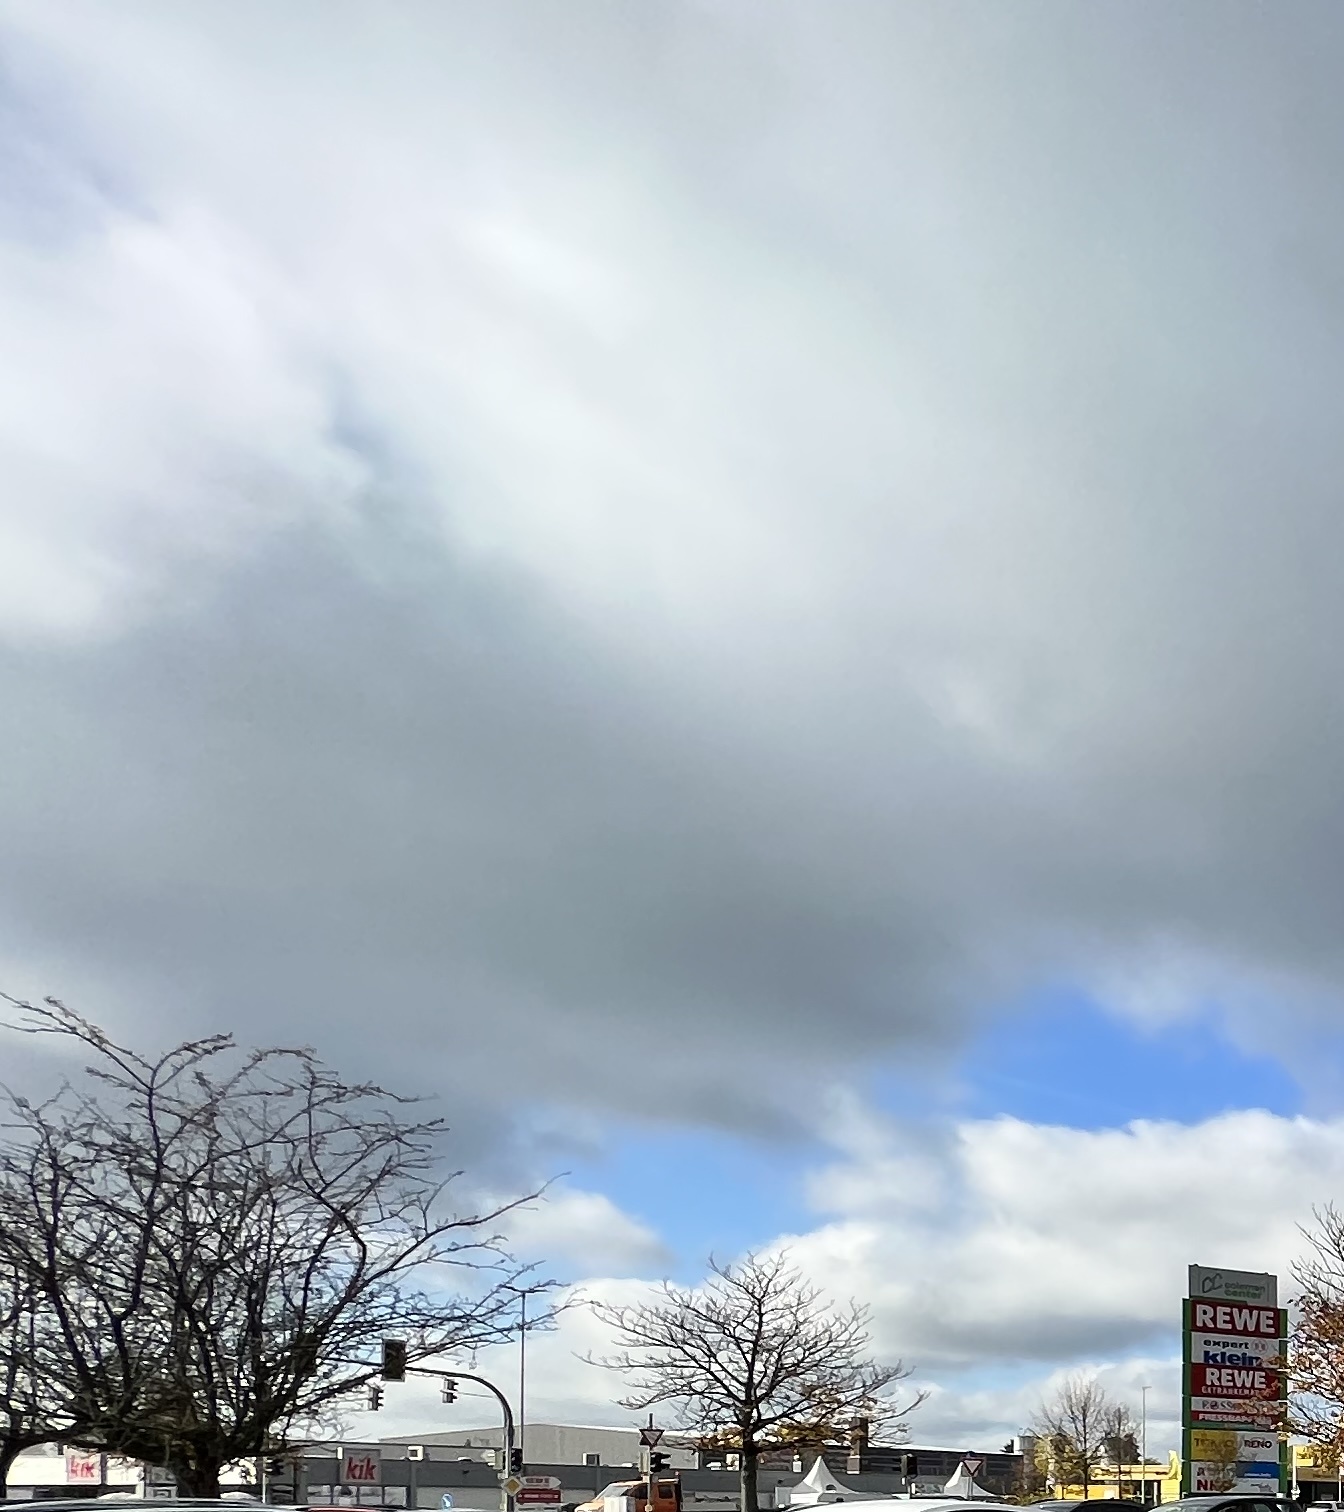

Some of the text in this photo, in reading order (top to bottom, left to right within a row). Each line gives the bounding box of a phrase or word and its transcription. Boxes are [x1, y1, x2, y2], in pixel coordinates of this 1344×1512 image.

[1196, 1304, 1275, 1333] REWE
[1203, 1339, 1249, 1349] expert
[1203, 1351, 1262, 1367] klein
[1206, 1368, 1266, 1388] REWE
[1244, 1440, 1273, 1449] RENO
[344, 1455, 376, 1480] kik
